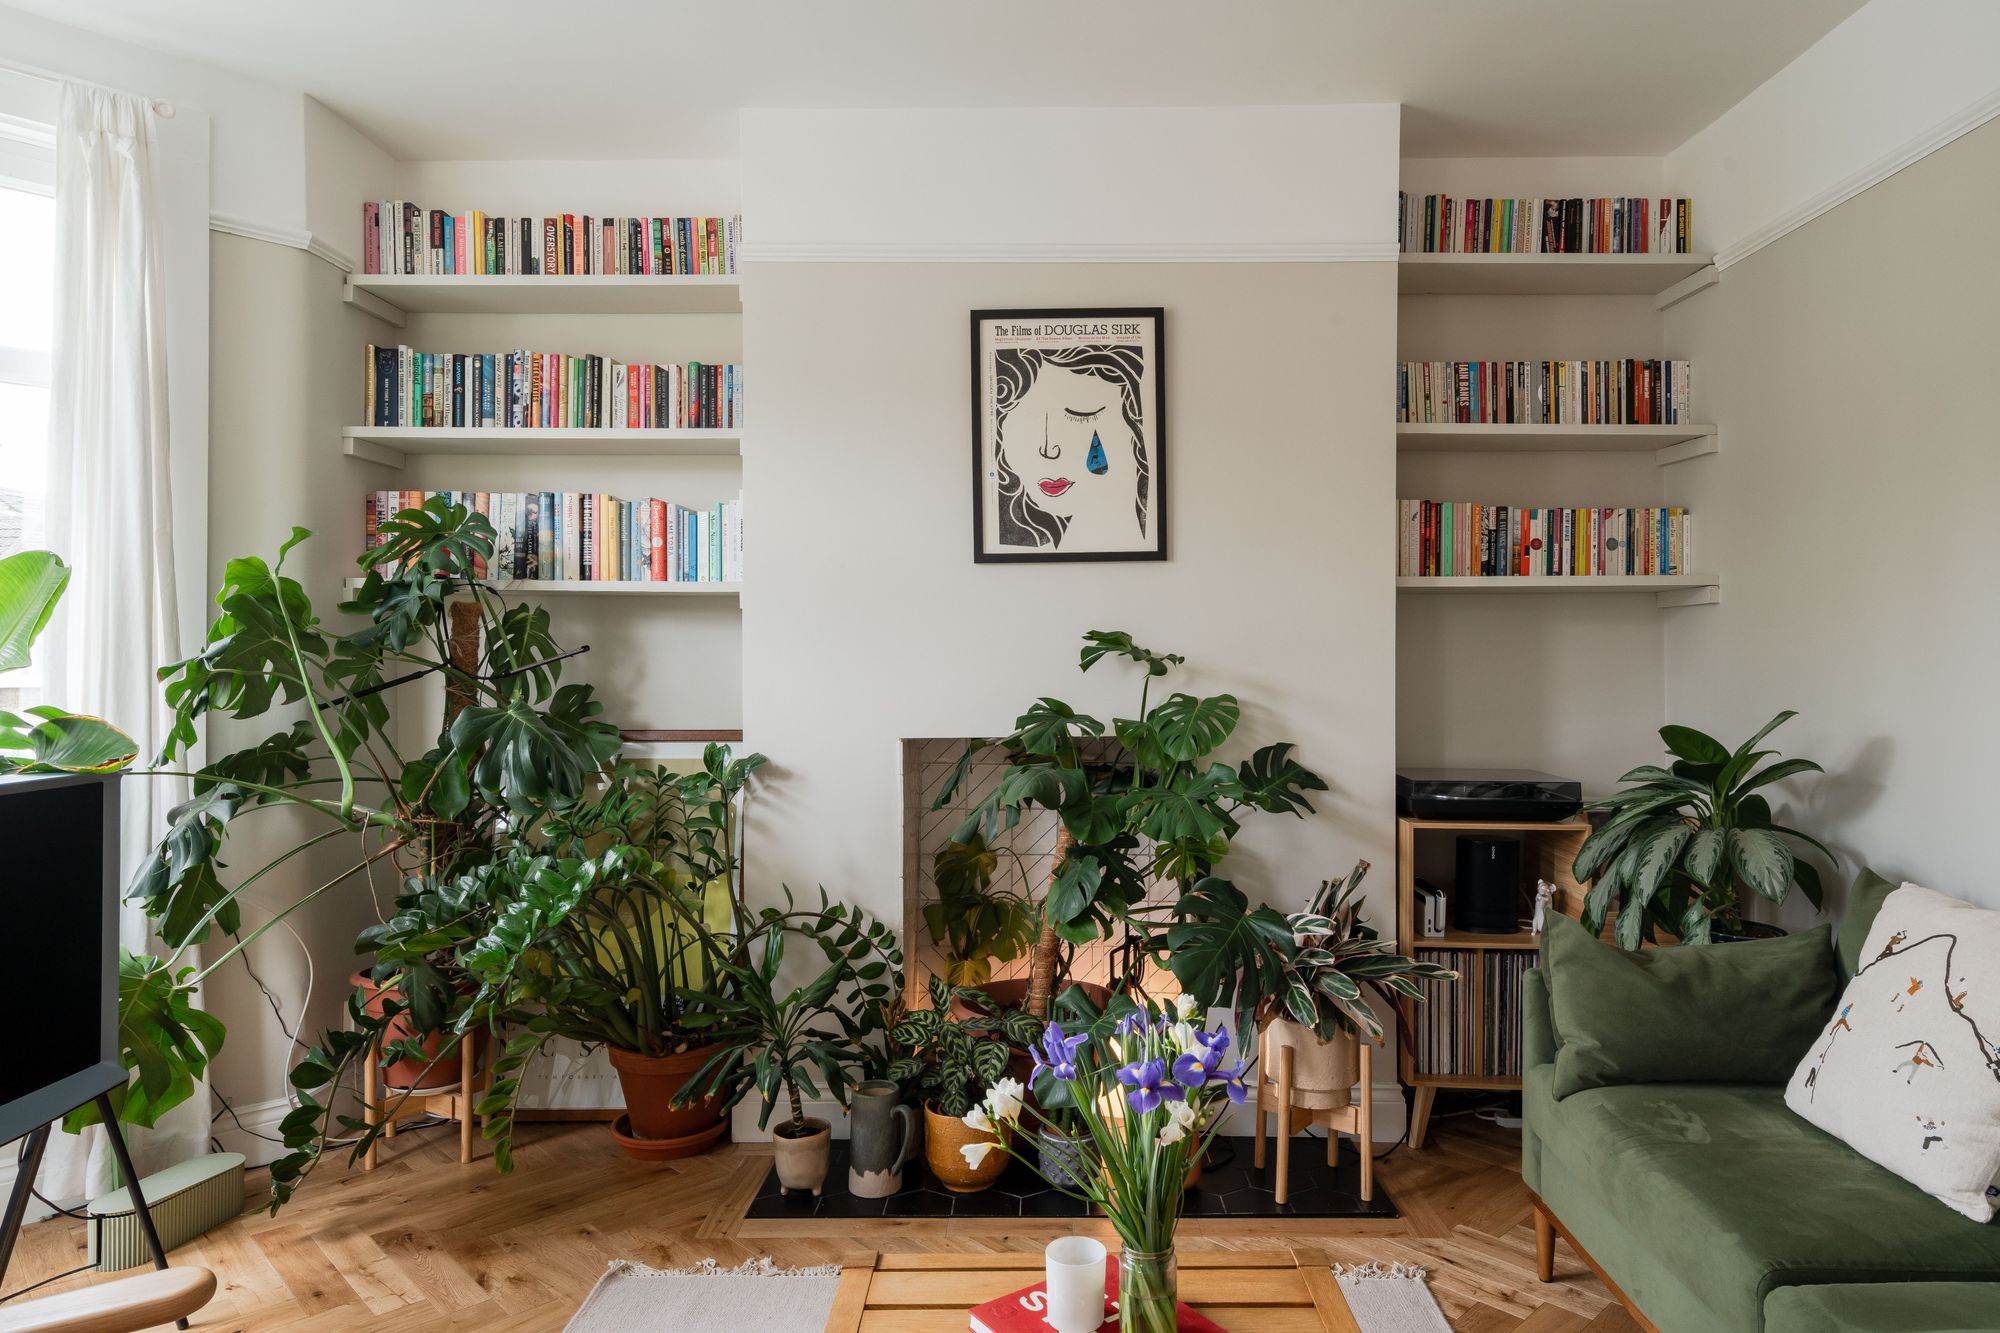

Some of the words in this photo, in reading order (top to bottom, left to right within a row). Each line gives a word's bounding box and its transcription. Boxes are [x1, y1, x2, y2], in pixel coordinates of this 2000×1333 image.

[546, 225, 556, 274] OVERSTORY
[994, 326, 1008, 336] The
[1012, 326, 1032, 336] Films
[1034, 325, 1041, 336] of
[1044, 324, 1108, 336] DOUGLAS
[1112, 324, 1140, 335] SIRK
[413, 356, 421, 385] astroturf
[532, 358, 541, 402] AFTERPARTIES
[1460, 364, 1469, 380] IAIN
[1460, 382, 1470, 406] BANKS
